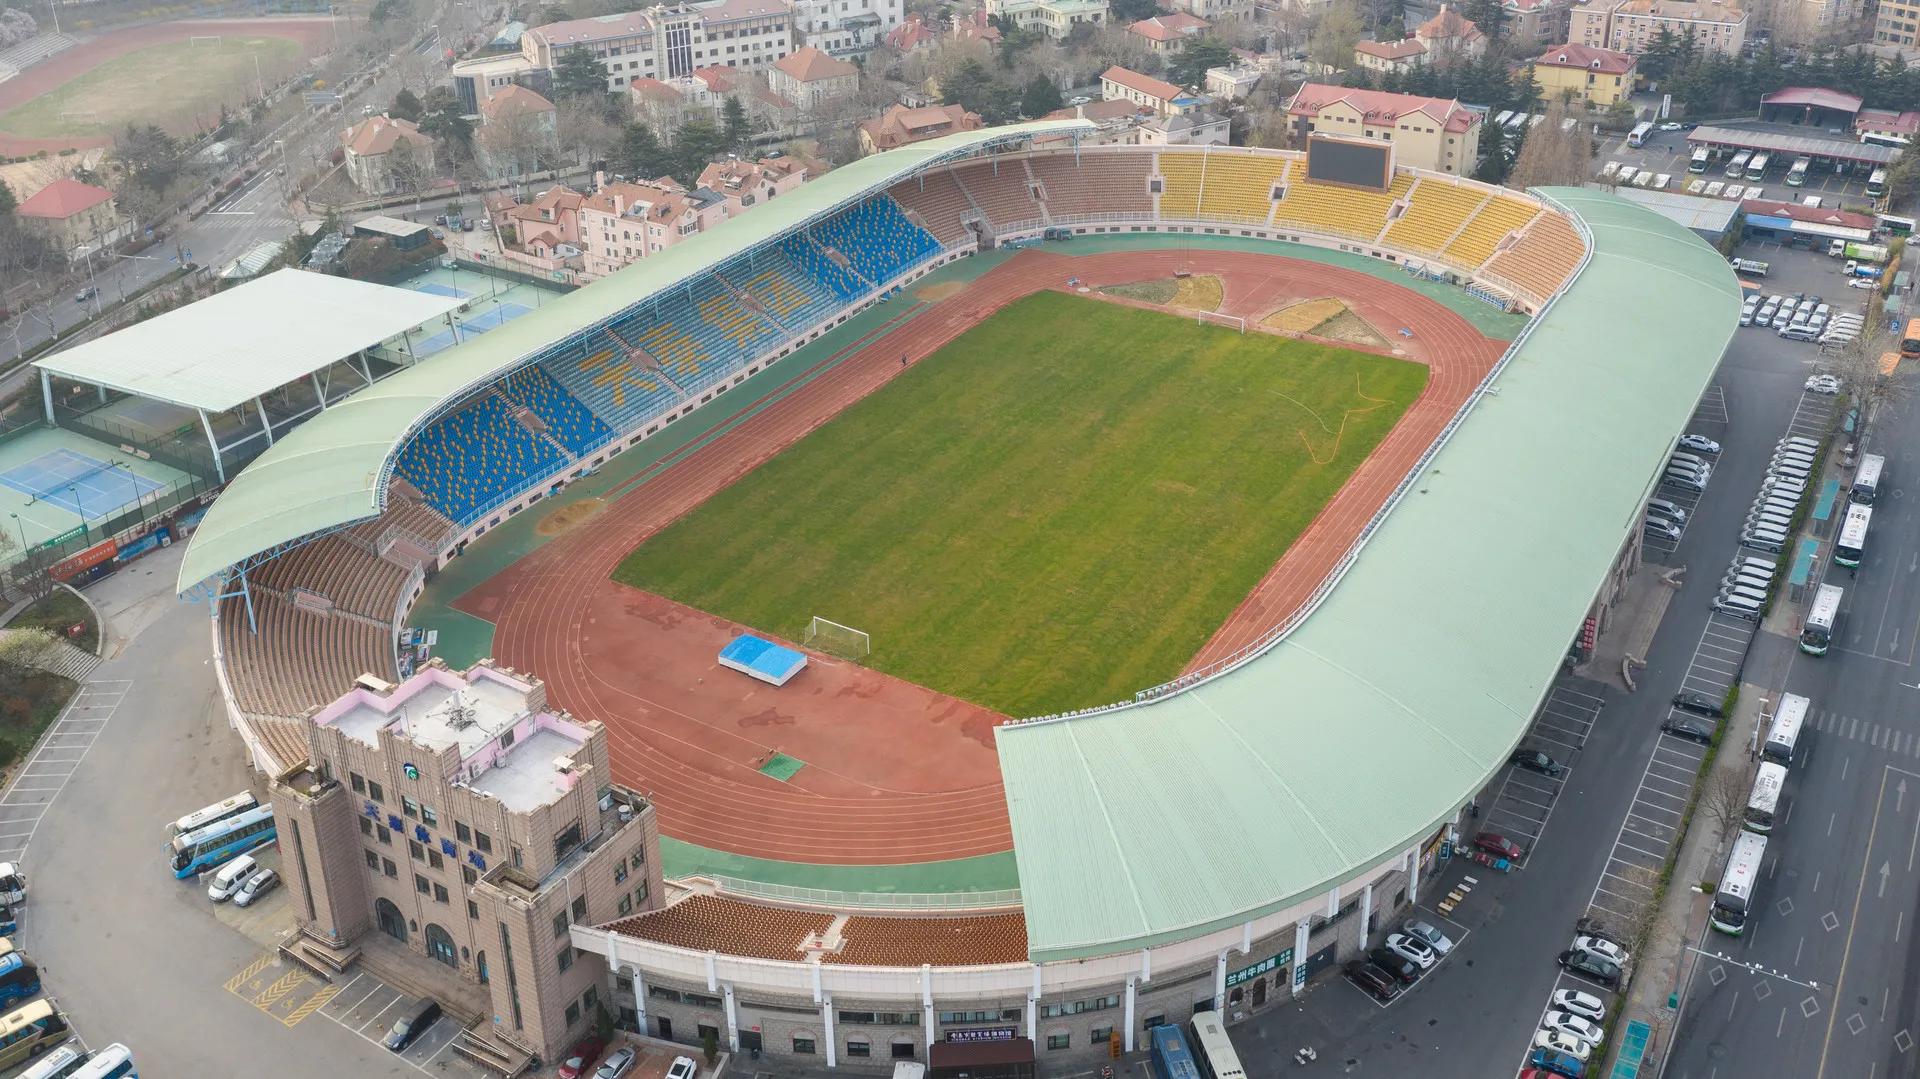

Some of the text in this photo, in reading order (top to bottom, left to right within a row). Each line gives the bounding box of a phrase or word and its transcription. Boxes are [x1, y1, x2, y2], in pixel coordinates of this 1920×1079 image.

[364, 800, 487, 872] 天泰体育场
[1227, 957, 1276, 986] 兰州牛肉面
